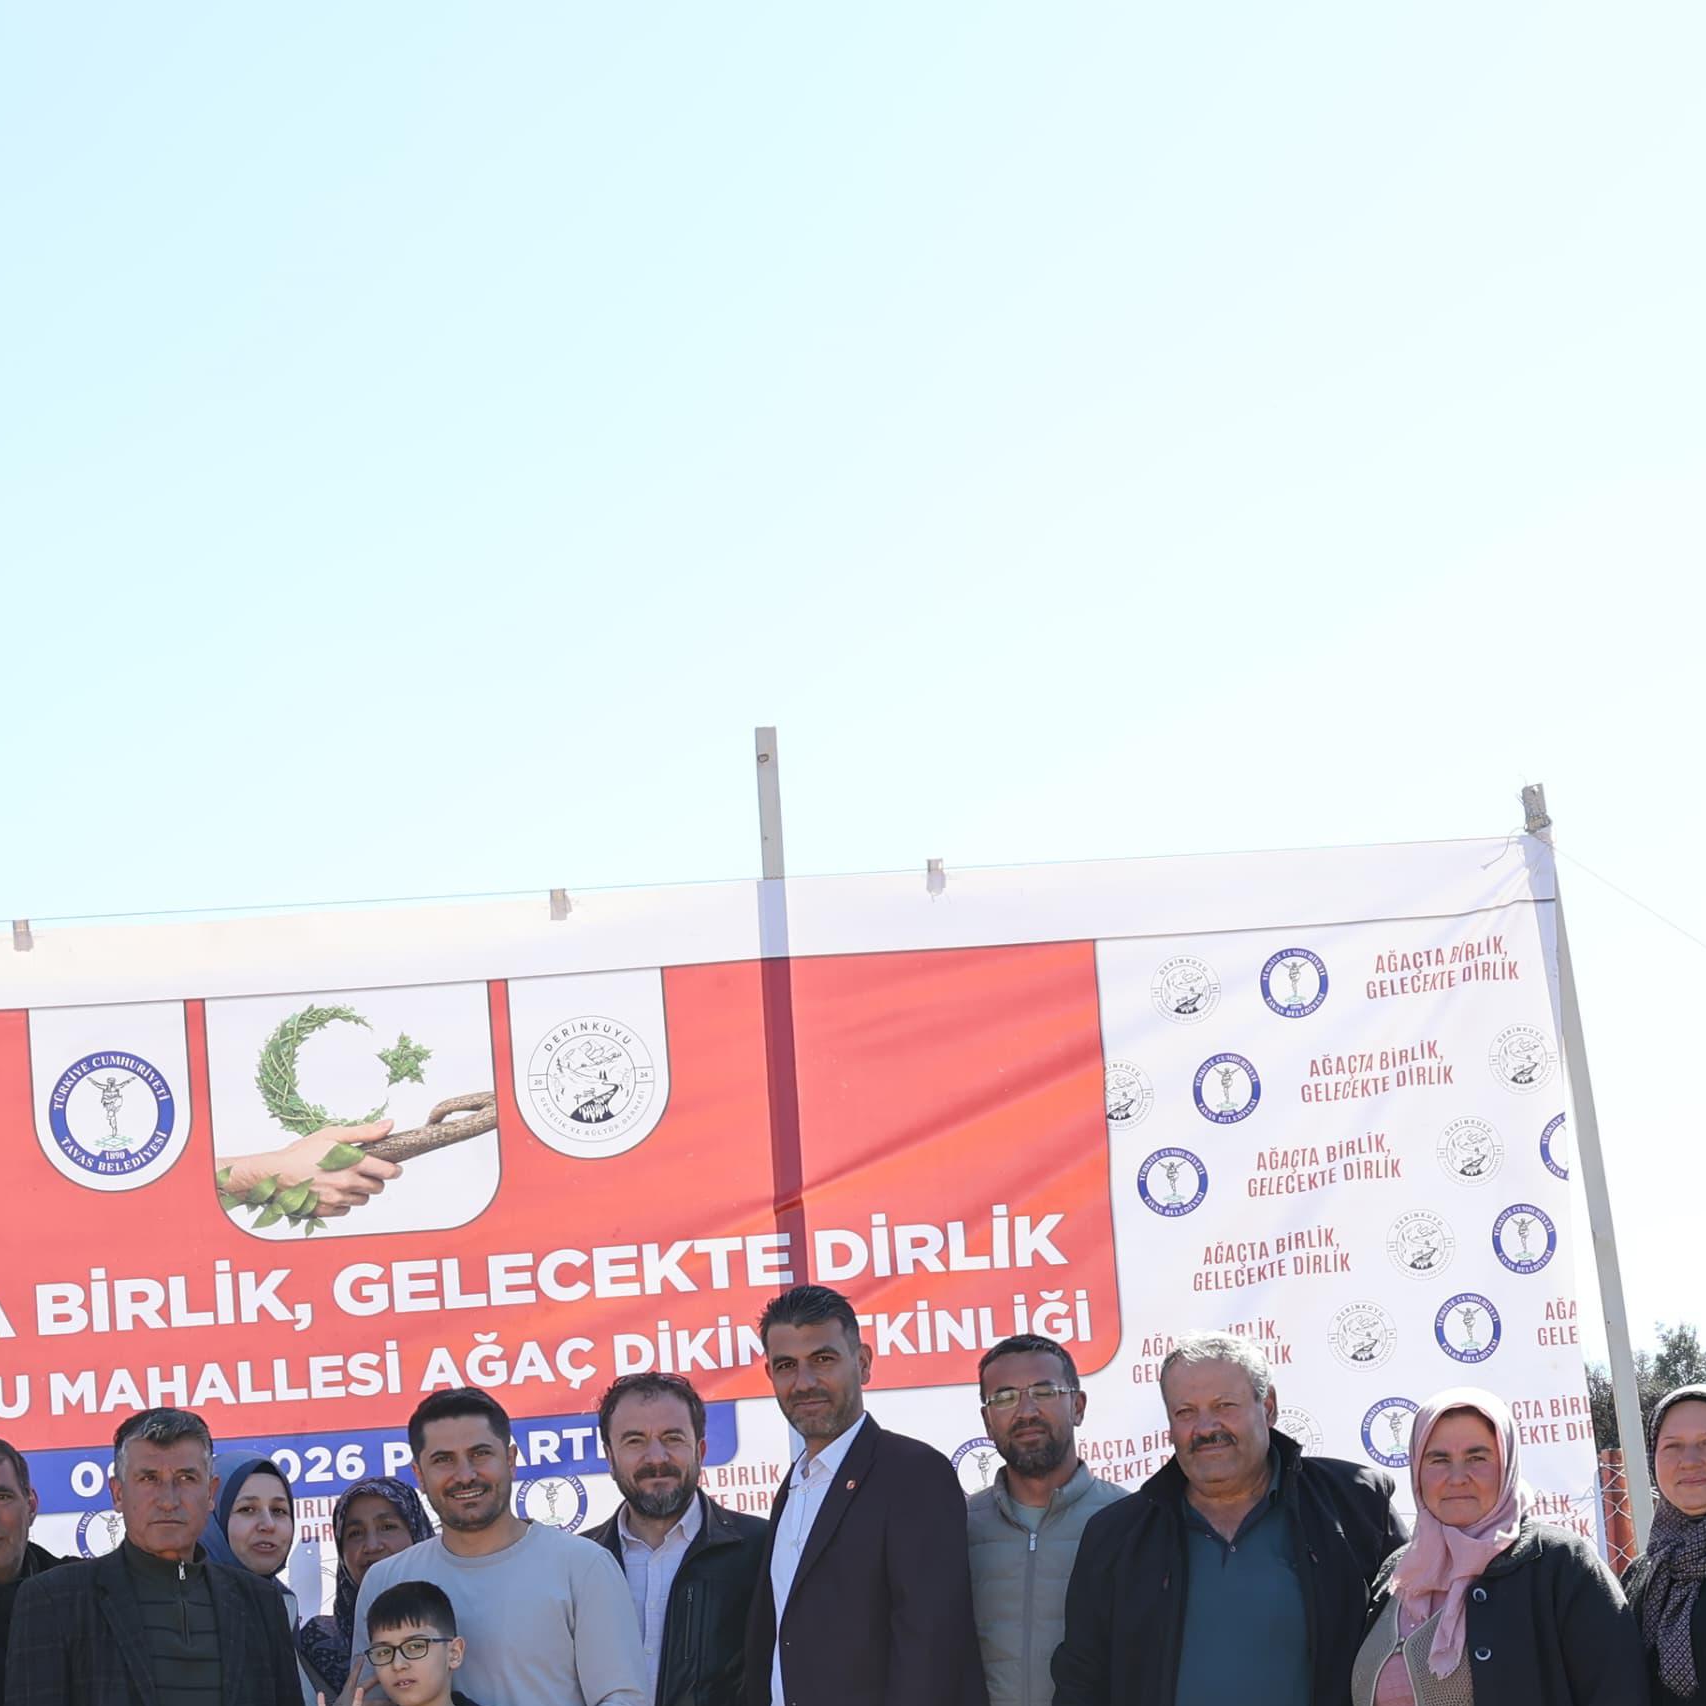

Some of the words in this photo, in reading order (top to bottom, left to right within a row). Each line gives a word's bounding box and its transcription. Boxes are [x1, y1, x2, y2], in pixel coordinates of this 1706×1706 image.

[1365, 968, 1457, 1000] GELECEKTE
[1461, 957, 1520, 983] DİRLİK
[1374, 948, 1445, 983] AĞAÇTA
[1449, 935, 1509, 967] BİRLİK,
[544, 1022, 631, 1052] DERİNKUYU
[1309, 1050, 1374, 1084] AĞAÇTA
[1378, 1039, 1445, 1071] BİRLİK,
[53, 1062, 91, 1111] TÜRKİYE
[92, 1055, 170, 1101] CUMHURİYETİ
[1300, 1075, 1390, 1103] GELECEKTE
[1396, 1063, 1454, 1089] DİRLİK
[60, 1136, 94, 1168] TAVAS
[98, 1130, 167, 1172] BELEDİYESİ
[1256, 1148, 1320, 1180] AĞAÇTA
[1325, 1132, 1393, 1161] BİRLİK,
[1247, 1168, 1337, 1198] GELECEKTE
[1342, 1156, 1402, 1182] DİRLİK
[1203, 1242, 1269, 1268] AĞAÇTA
[1276, 1225, 1340, 1255] BİRLİK,
[35, 1259, 313, 1332] BİRLİK,
[332, 1232, 794, 1318] GELECEKTE
[813, 1204, 1068, 1285] DİRLİK
[1193, 1259, 1287, 1291] GELECEKTE
[1293, 1250, 1351, 1275] DİRLİK
[1544, 1297, 1577, 1321] AĞA
[1142, 1333, 1174, 1357] AĞA
[1228, 1317, 1281, 1344] İRLİK,
[51, 1341, 401, 1417] MAHALLESİ
[419, 1334, 598, 1393] AĞAÇ
[1079, 1439, 1135, 1465] ĞAÇTA
